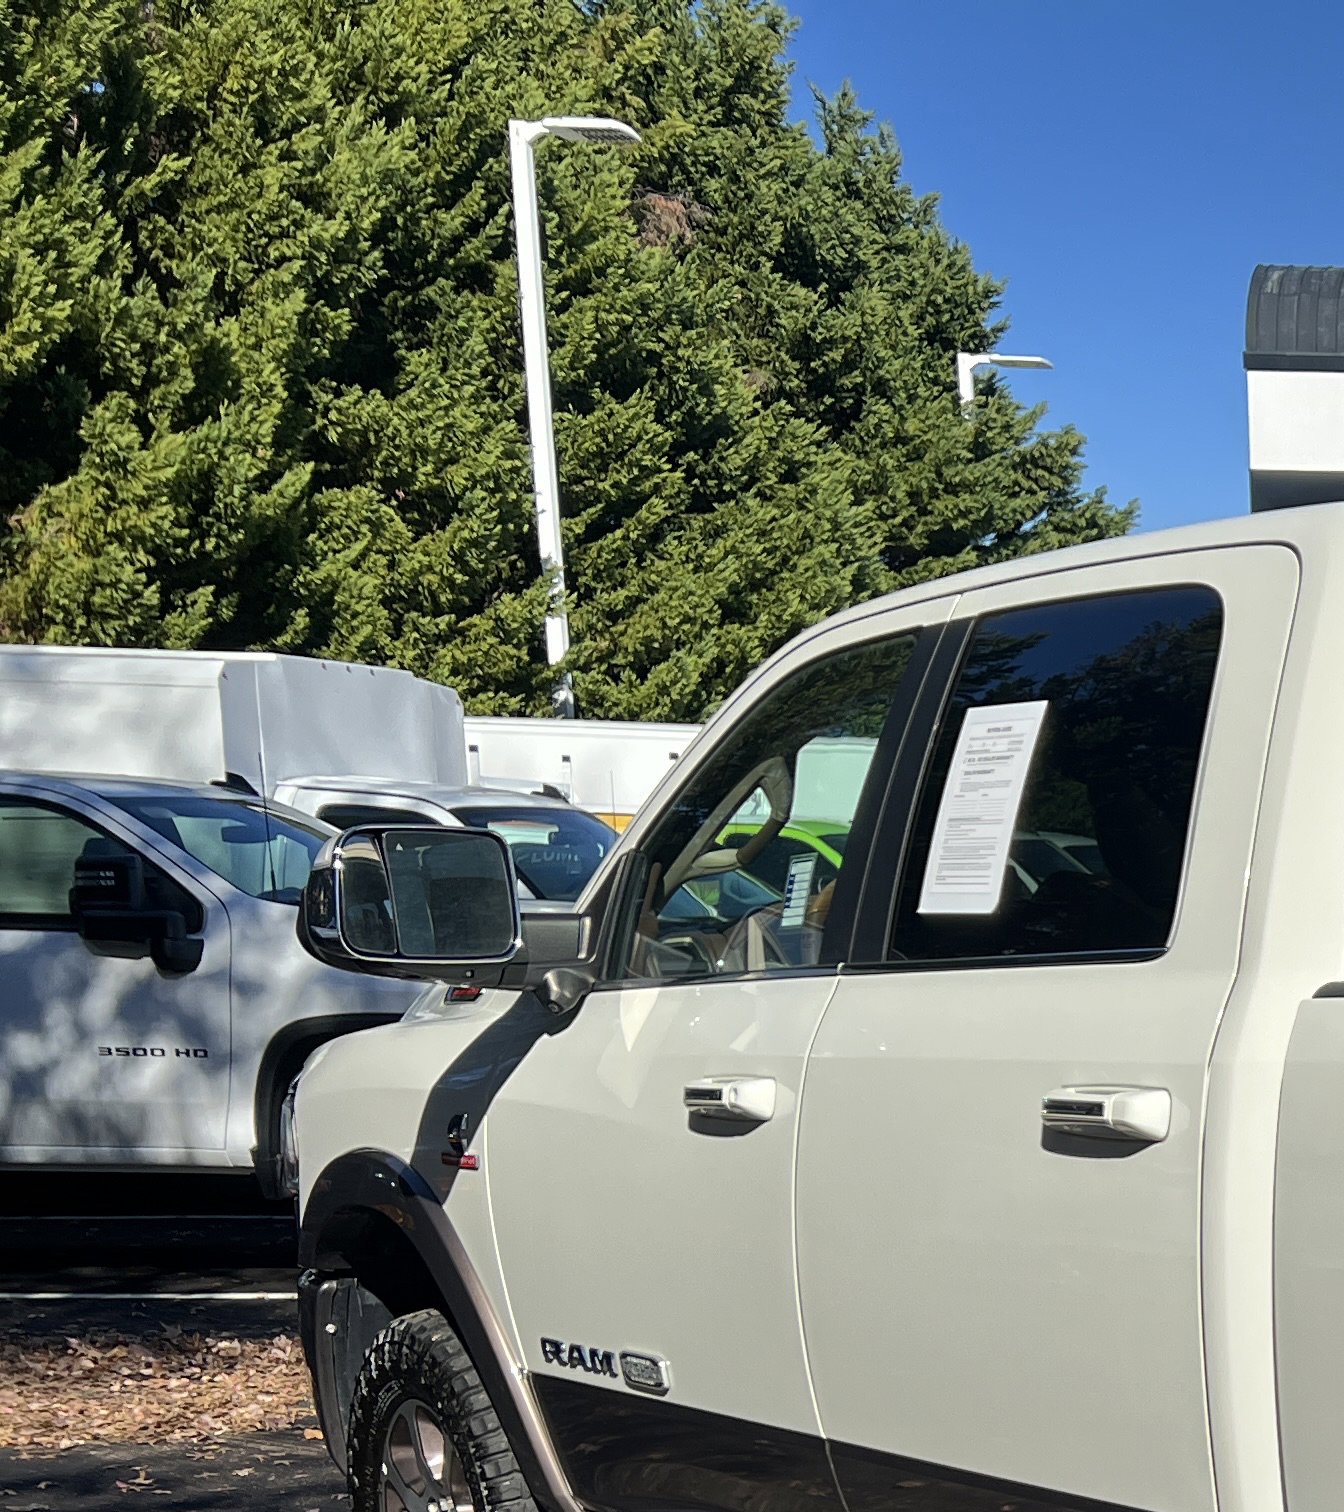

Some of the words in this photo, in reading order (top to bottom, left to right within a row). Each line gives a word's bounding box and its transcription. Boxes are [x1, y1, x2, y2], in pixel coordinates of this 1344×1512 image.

[98, 1045, 166, 1058] 3500
[174, 1047, 209, 1059] HD
[540, 1337, 618, 1379] RAM
